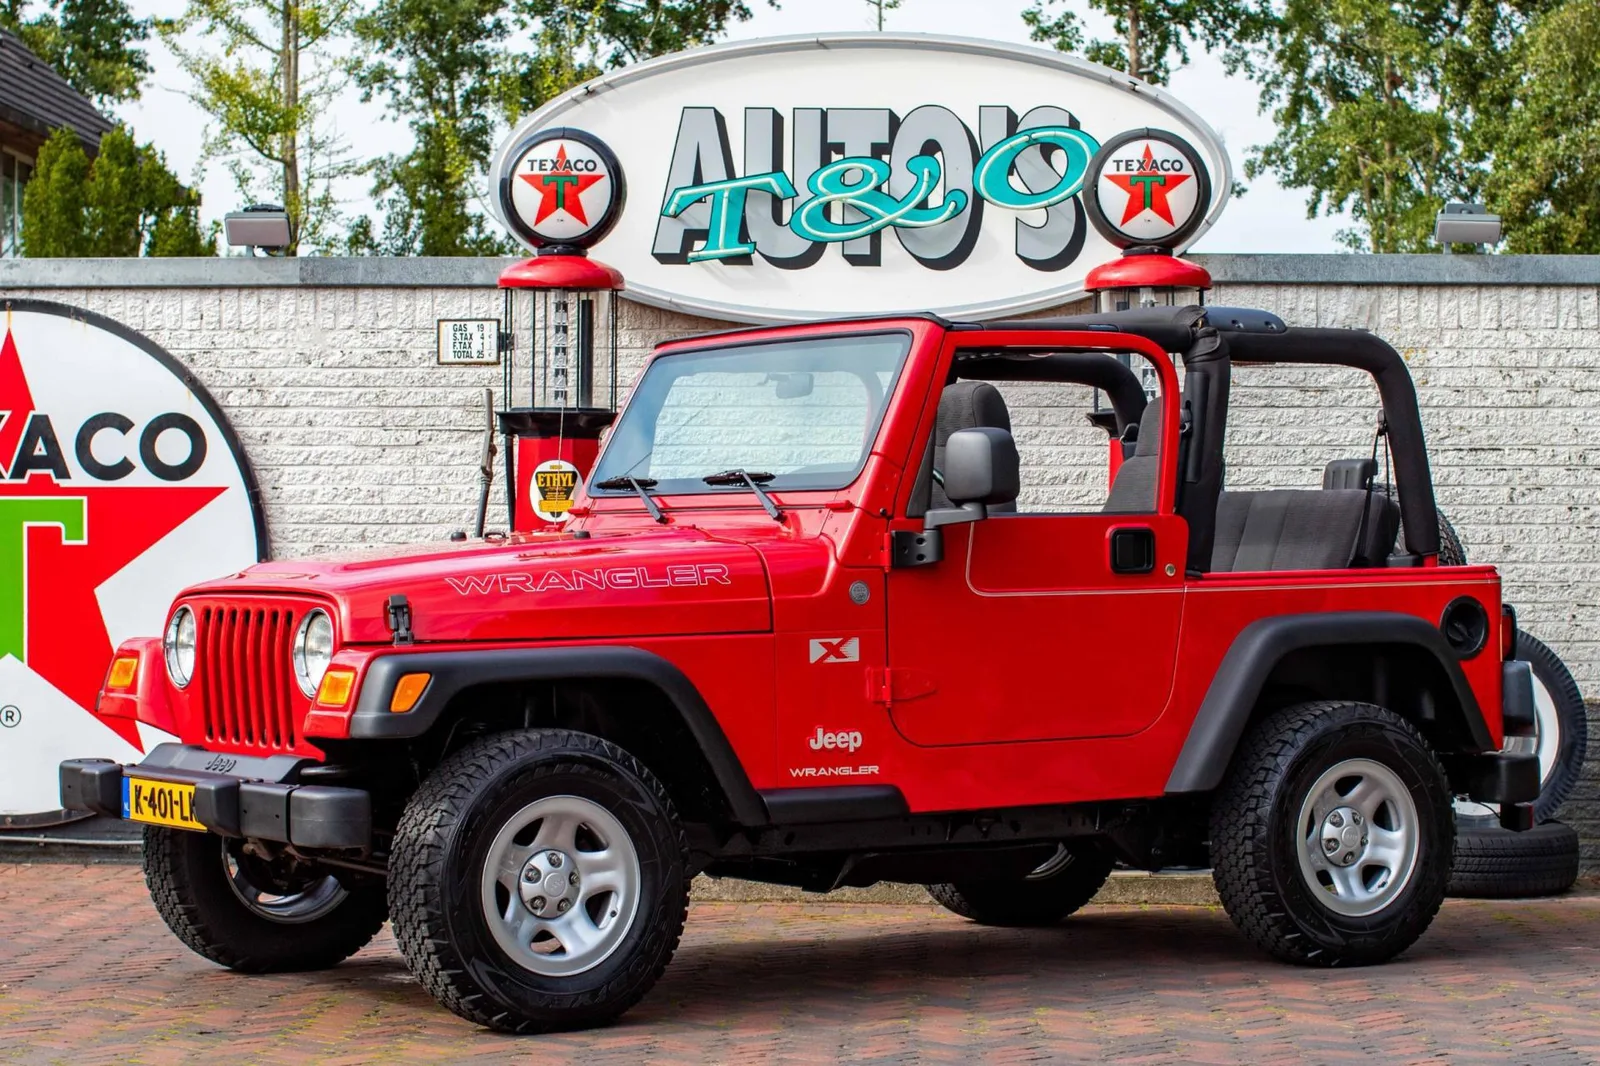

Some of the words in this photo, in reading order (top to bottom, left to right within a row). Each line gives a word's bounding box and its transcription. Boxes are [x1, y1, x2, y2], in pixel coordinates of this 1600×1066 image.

[527, 159, 597, 172] TEXACO
[1113, 159, 1183, 172] TEXACO
[543, 175, 579, 209] T
[652, 105, 1087, 272] AUTO'S
[660, 170, 797, 264] T
[790, 153, 969, 243] &
[973, 125, 1101, 211] O
[1129, 175, 1166, 210] T
[452, 323, 468, 332] GAS
[477, 323, 485, 332] 19
[452, 332, 474, 341] S.TAX
[452, 341, 473, 350] F.TAX
[452, 350, 474, 359] TOTAL
[476, 350, 485, 359] 25
[0, 412, 207, 481] ACO
[537, 473, 574, 487] ETHYL
[445, 563, 731, 595] WRANGLER
[809, 727, 863, 753] Jeep
[205, 754, 237, 775] Jeep
[790, 765, 880, 778] WRANGLER
